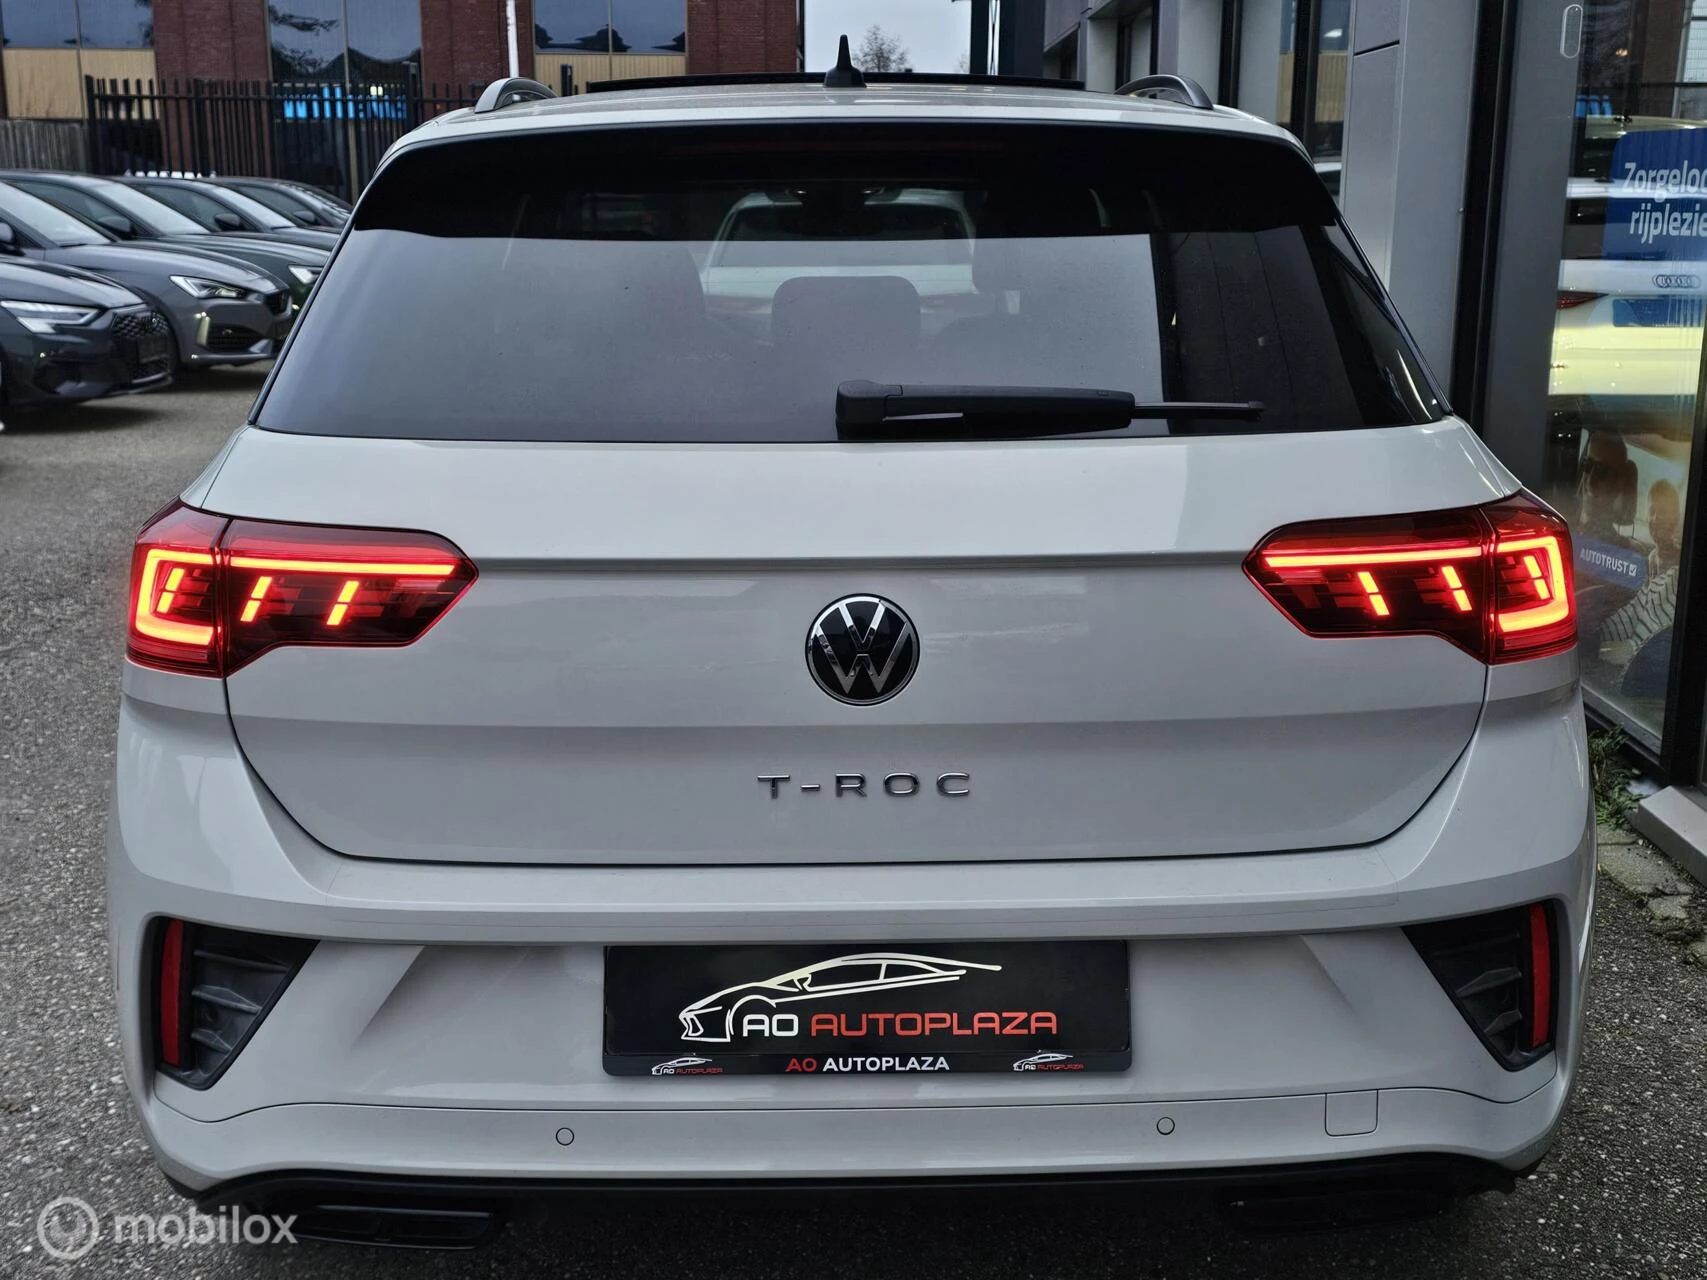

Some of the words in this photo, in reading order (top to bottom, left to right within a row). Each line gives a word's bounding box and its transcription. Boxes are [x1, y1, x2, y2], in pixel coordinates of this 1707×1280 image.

[1580, 548, 1629, 574] AUTOTRUST
[757, 772, 970, 798] T-ROC
[743, 1013, 799, 1037] AO
[810, 1011, 1057, 1037] AUTOPLAZA
[785, 1057, 817, 1072] AO
[822, 1056, 950, 1072] AUTOPLAZA
